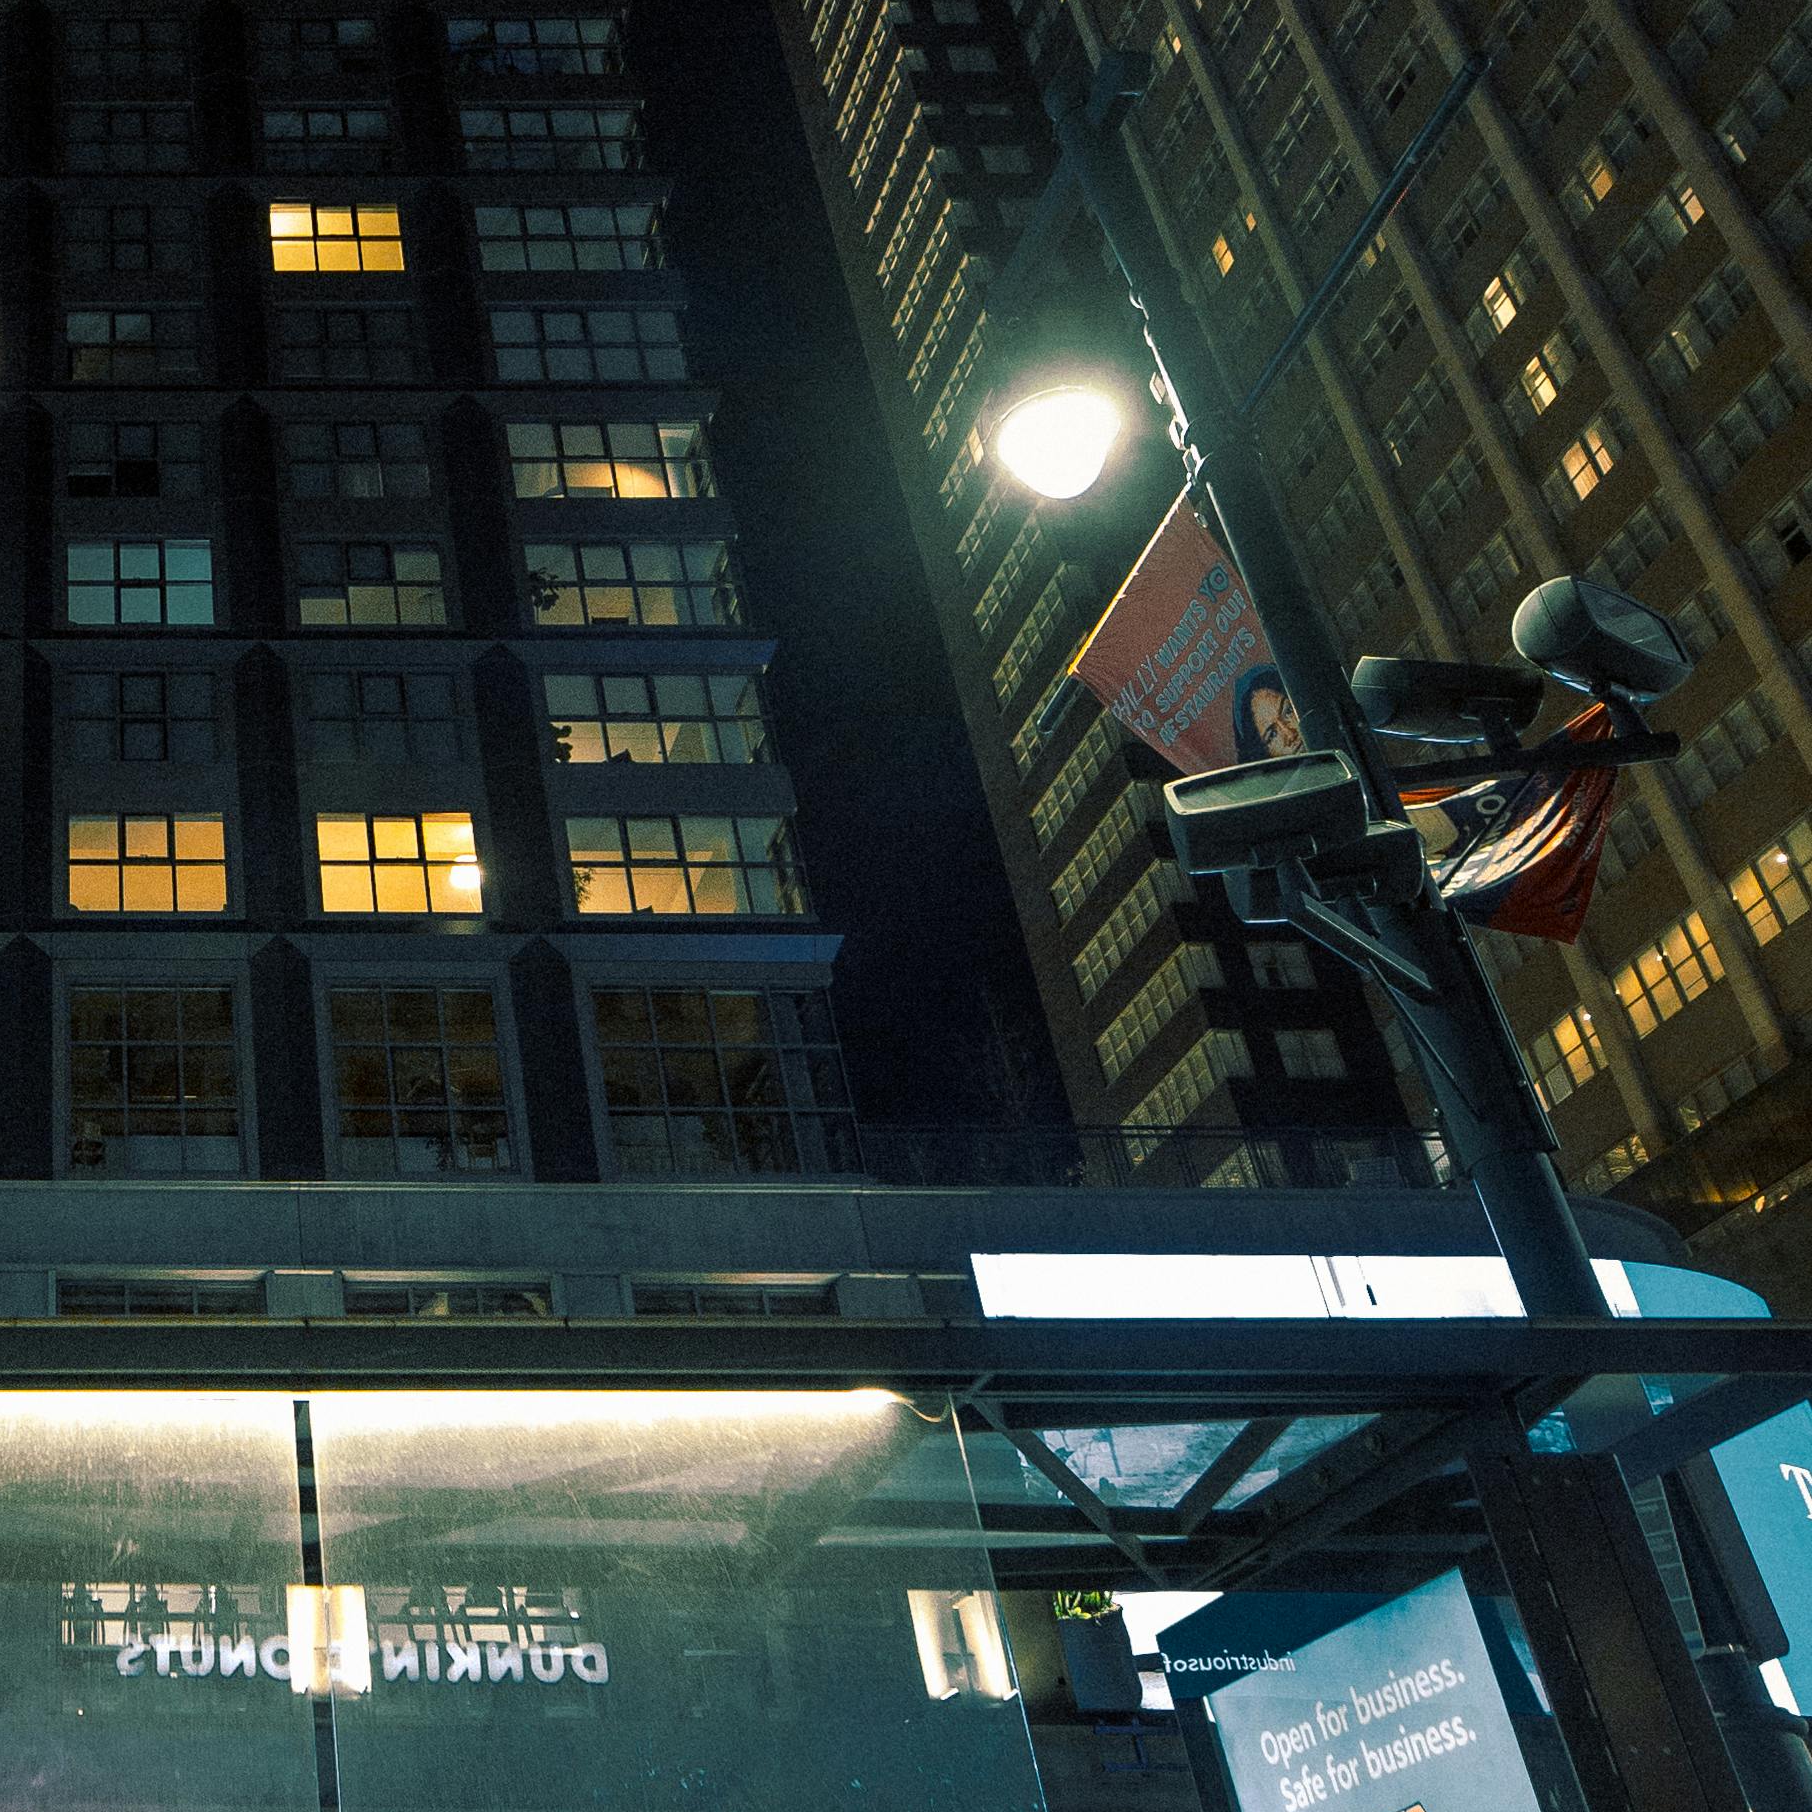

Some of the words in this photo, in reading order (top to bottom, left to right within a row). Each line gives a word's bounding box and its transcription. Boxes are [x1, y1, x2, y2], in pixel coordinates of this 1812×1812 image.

[1155, 599, 1208, 669] WANTS
[1155, 629, 1220, 713] SUPPORT
[1158, 627, 1257, 747] RESTAURANTS
[1260, 1721, 1317, 1770] Open
[1315, 1701, 1349, 1741] for
[1349, 1658, 1466, 1725] business.
[1280, 1764, 1328, 1812] Safe
[1325, 1754, 1361, 1794] for
[1359, 1716, 1477, 1780] business.
